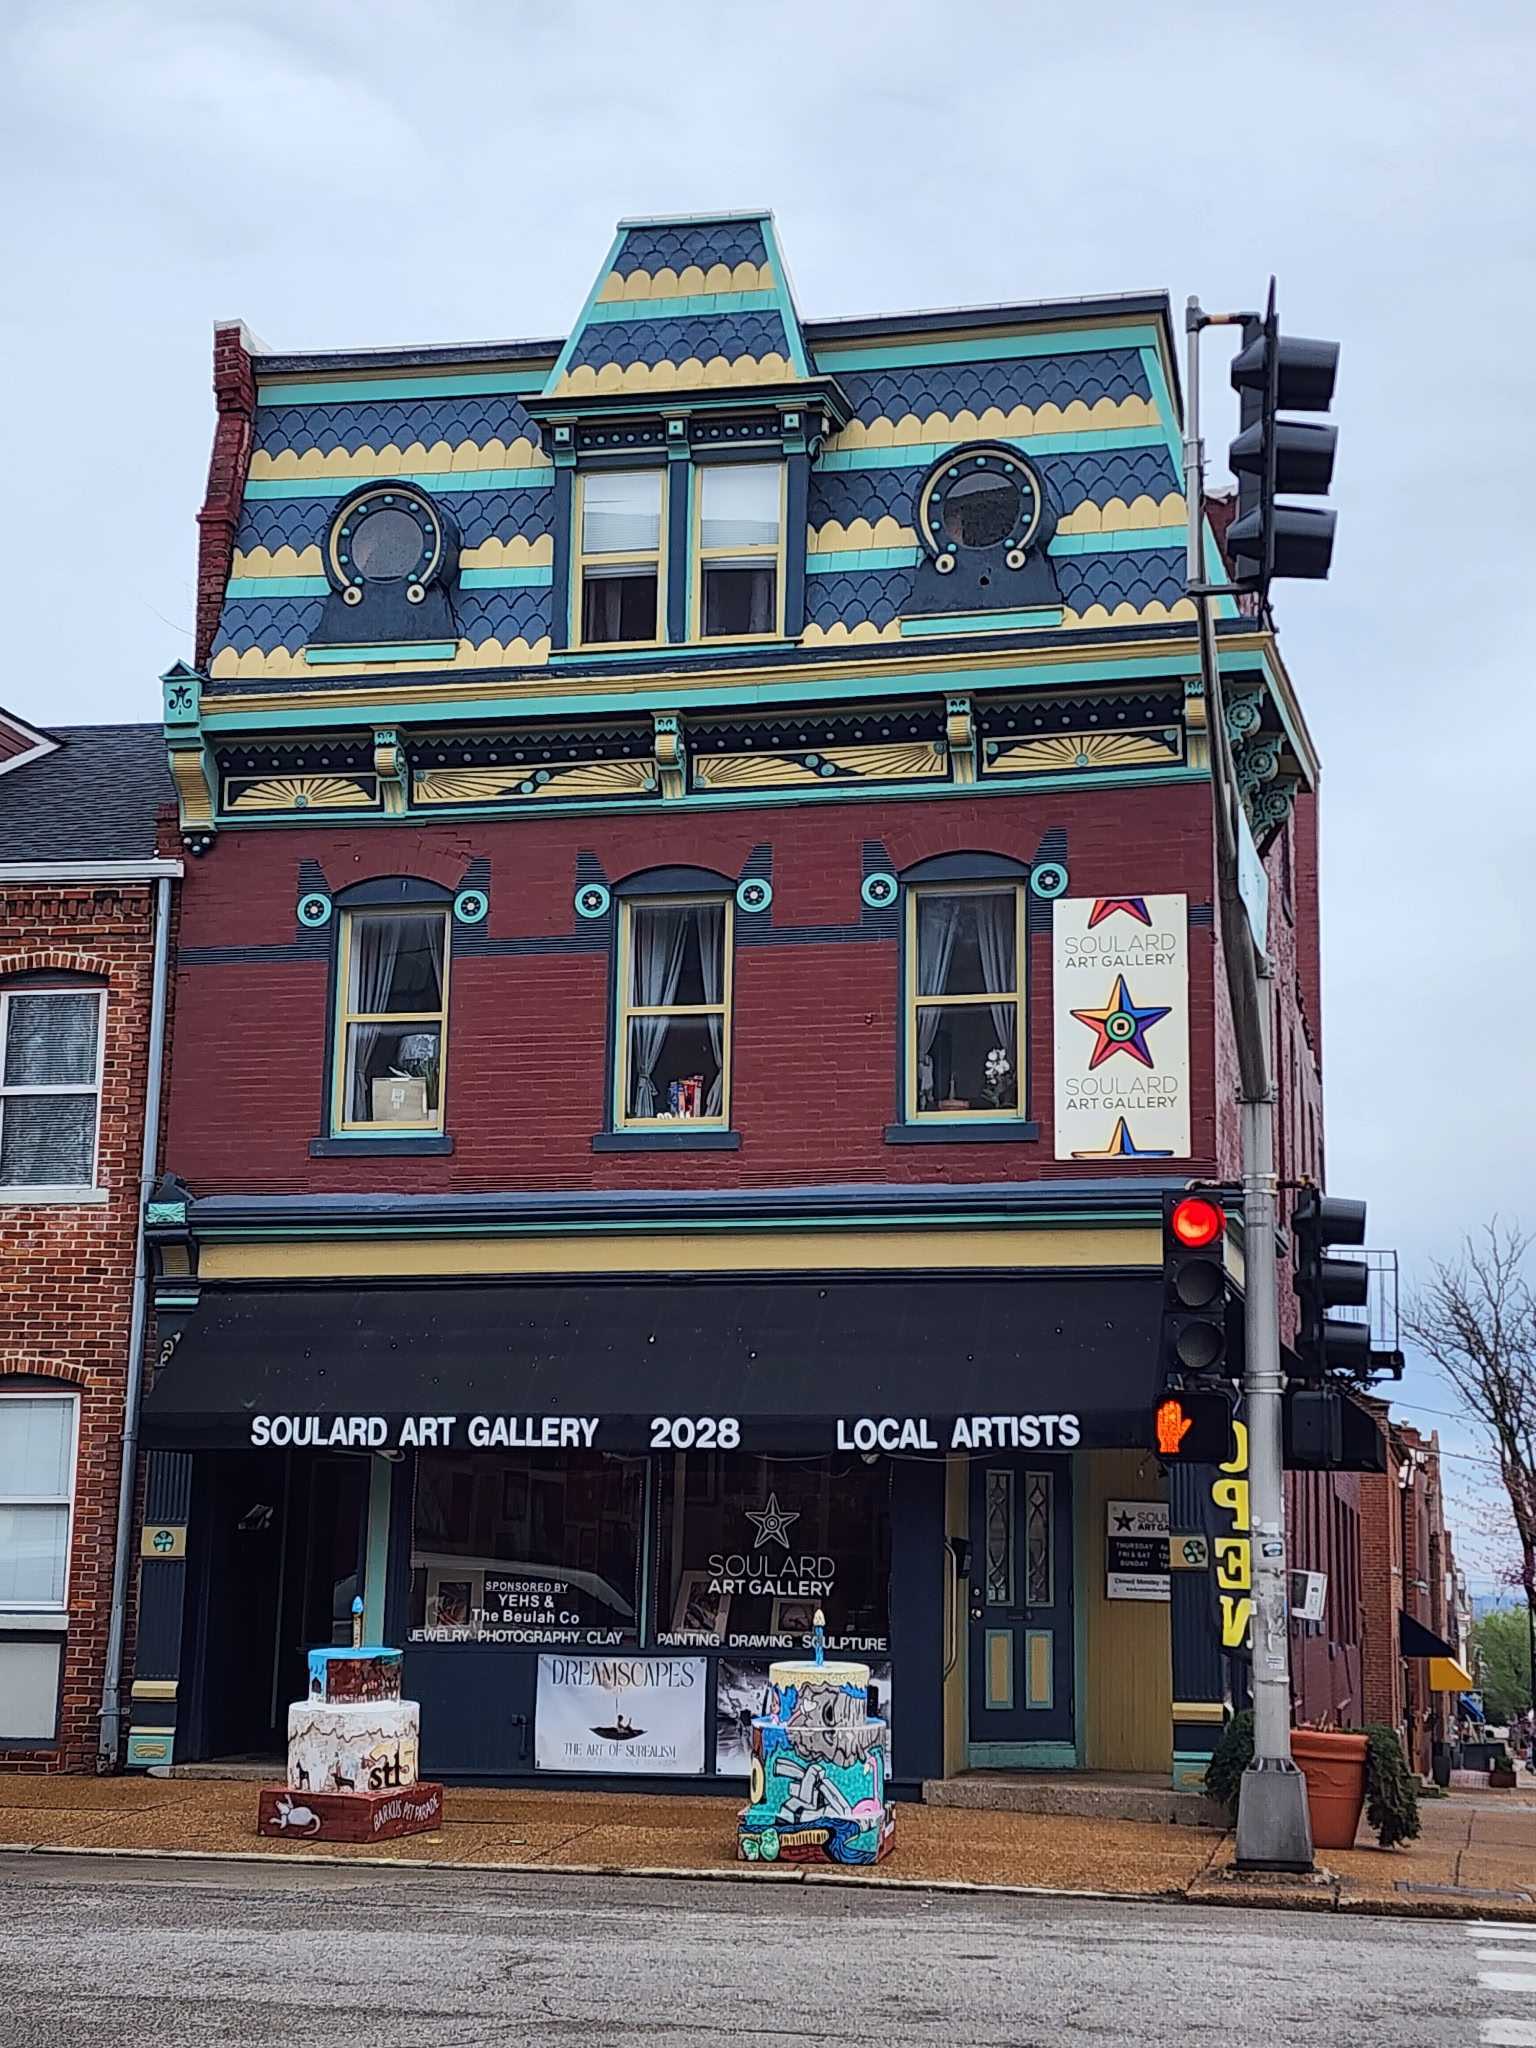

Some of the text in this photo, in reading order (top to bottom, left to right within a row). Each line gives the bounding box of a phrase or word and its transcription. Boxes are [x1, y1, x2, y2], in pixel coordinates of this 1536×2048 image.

[1064, 933, 1176, 954] SOULARD
[1065, 953, 1176, 968] ART GALLERY
[1065, 1076, 1178, 1096] SOULARD
[1066, 1096, 1178, 1110] ART GALLERY
[250, 1414, 1081, 1450] SOULARD ART GALLERY 2028 LOCAL ARTISTS
[1116, 1543, 1154, 1551] THURSDAY
[707, 1554, 835, 1579] SOULARD
[485, 1581, 568, 1592] SPONSORED BY
[707, 1580, 835, 1597] ART GALLERY
[499, 1595, 554, 1608] YEHS &
[472, 1609, 579, 1624] The Beulah Co
[408, 1629, 623, 1645] JEWELRY PHOTOGRAPHY CLAY
[657, 1633, 720, 1647] PAINTING
[729, 1634, 793, 1648] DRAWING
[552, 1659, 695, 1687] DREAMSCAPES
[565, 1743, 582, 1755] THE
[586, 1744, 603, 1756] ART
[609, 1744, 621, 1756] OF
[373, 1792, 440, 1832] BARKUS PET PARADE
